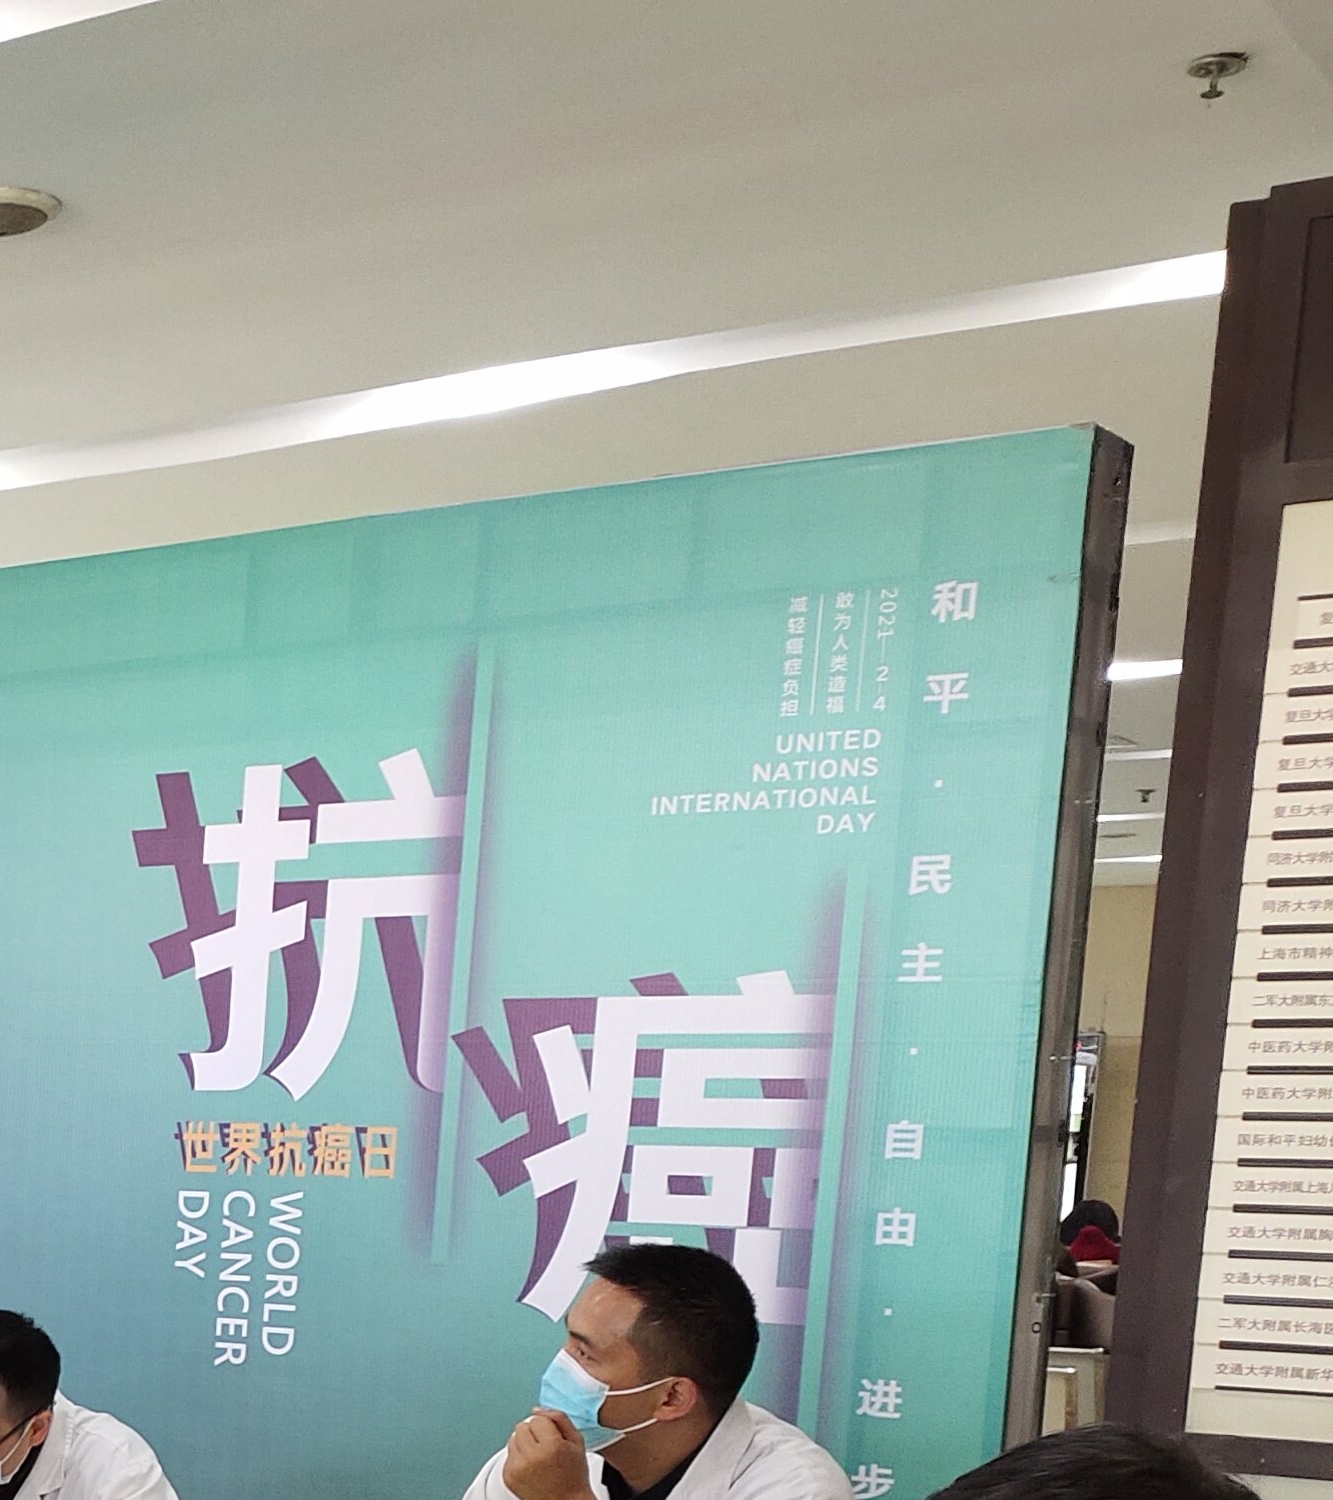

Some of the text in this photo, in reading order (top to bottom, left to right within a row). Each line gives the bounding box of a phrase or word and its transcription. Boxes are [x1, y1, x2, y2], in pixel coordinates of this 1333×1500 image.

[779, 596, 808, 717] 减轻癌症负担
[826, 591, 854, 714] 敢为人类造福
[1290, 660, 1333, 676] 交通大
[776, 728, 882, 754] UNITED
[752, 757, 880, 783] NATIONS
[650, 785, 877, 817] INTERNATIONAL
[816, 811, 876, 835] DAY
[1242, 1086, 1333, 1100] 中医药大学附
[174, 1120, 398, 1180] 世界抗癌日
[174, 1190, 210, 1279] DAY
[214, 1189, 256, 1367] CANCER
[261, 1191, 304, 1356] WORLD
